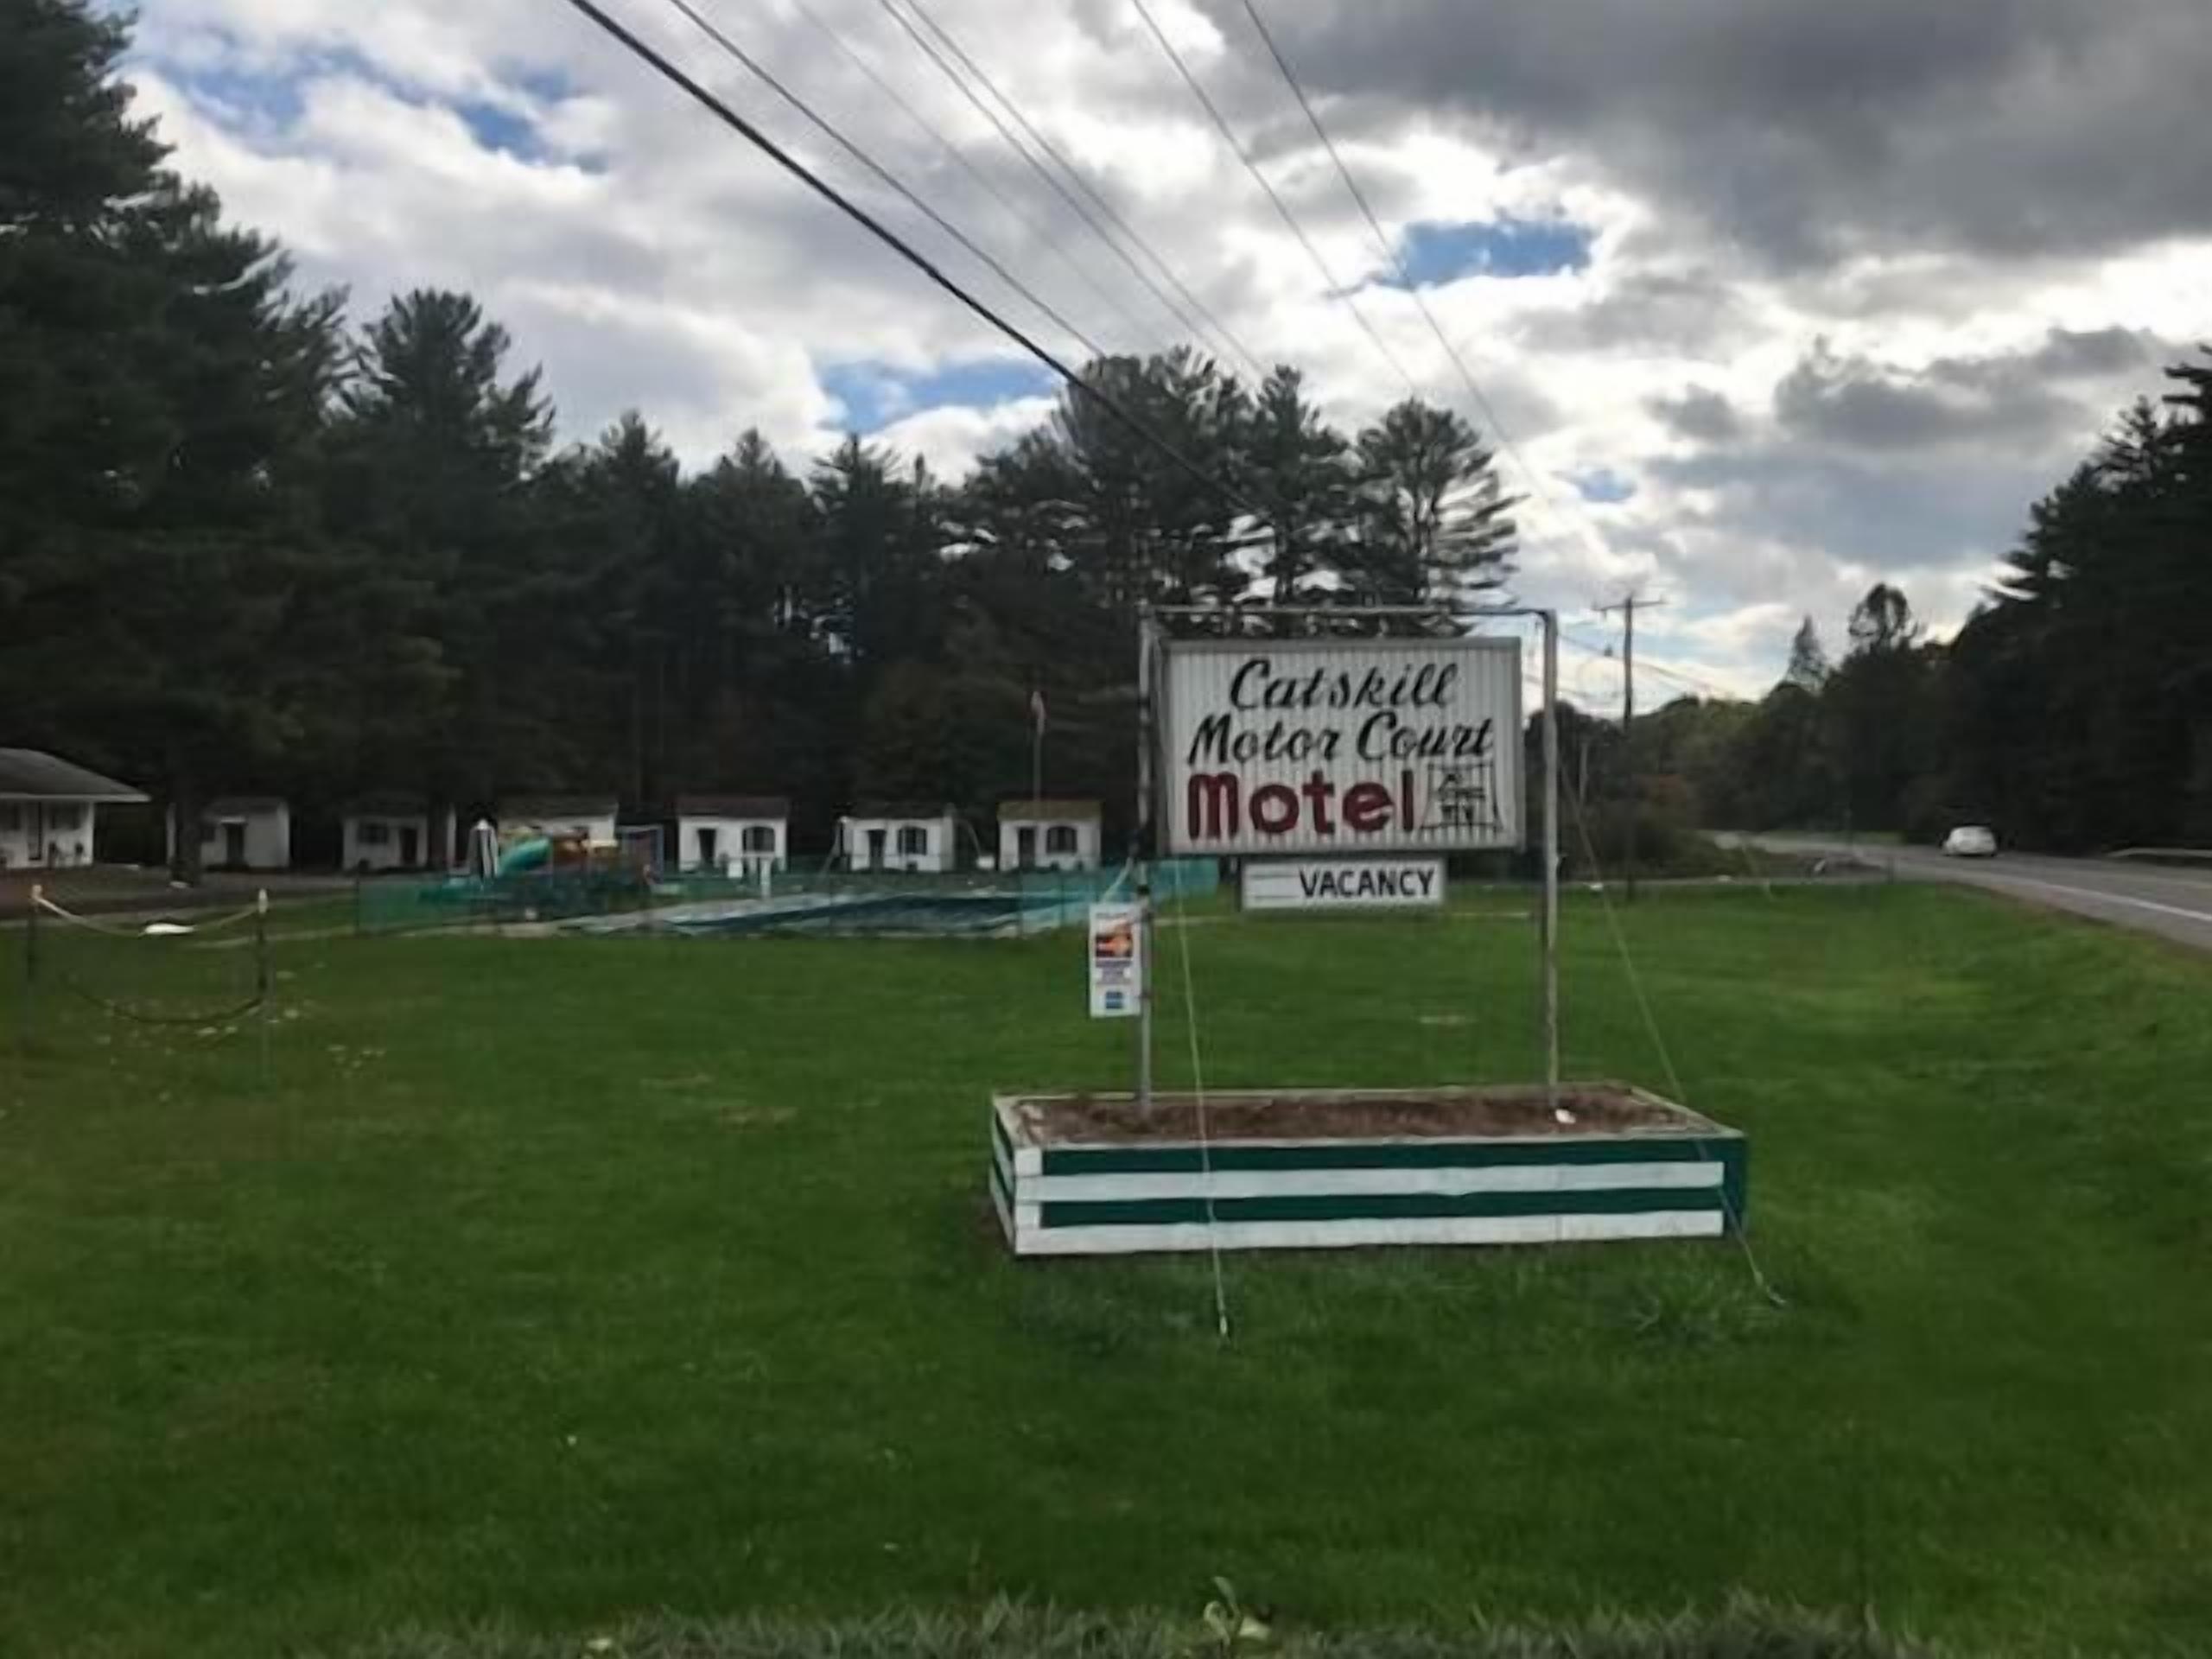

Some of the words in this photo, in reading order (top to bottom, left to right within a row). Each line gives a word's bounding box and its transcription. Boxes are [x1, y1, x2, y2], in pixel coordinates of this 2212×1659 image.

[1230, 658, 1459, 710] Catskill
[1187, 713, 1340, 766] Motor
[1357, 711, 1494, 760] Court
[1299, 869, 1435, 898] VACANCY
